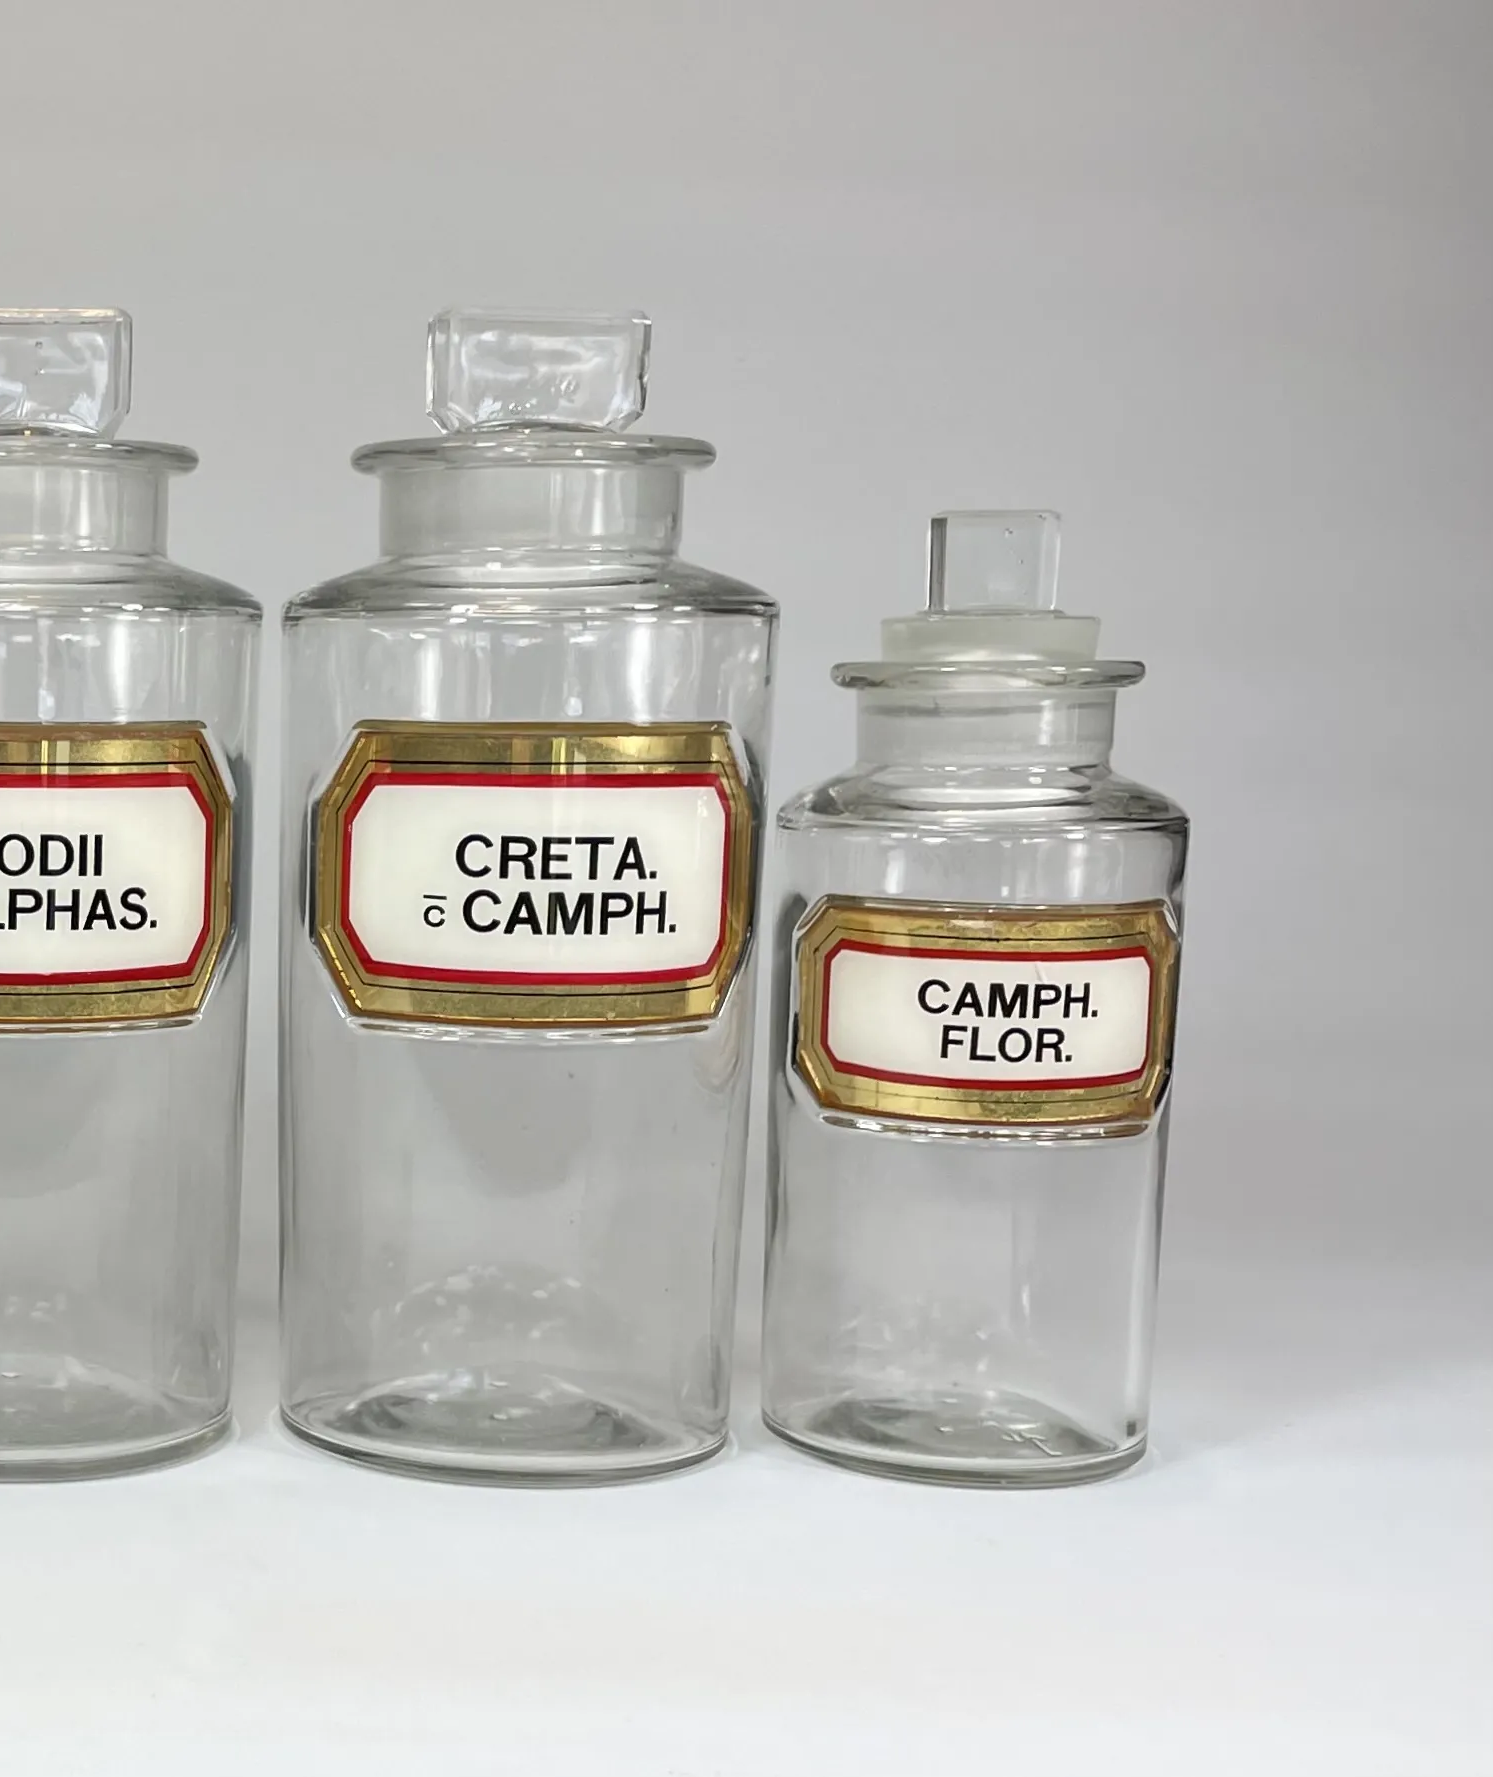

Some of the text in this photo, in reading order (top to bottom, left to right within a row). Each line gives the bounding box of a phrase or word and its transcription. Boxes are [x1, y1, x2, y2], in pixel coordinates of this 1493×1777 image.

[455, 834, 657, 881] CRETA.
[462, 889, 677, 936] CAMPH.
[917, 979, 1099, 1019] CAMPH.
[940, 1024, 1073, 1063] FLOR.
